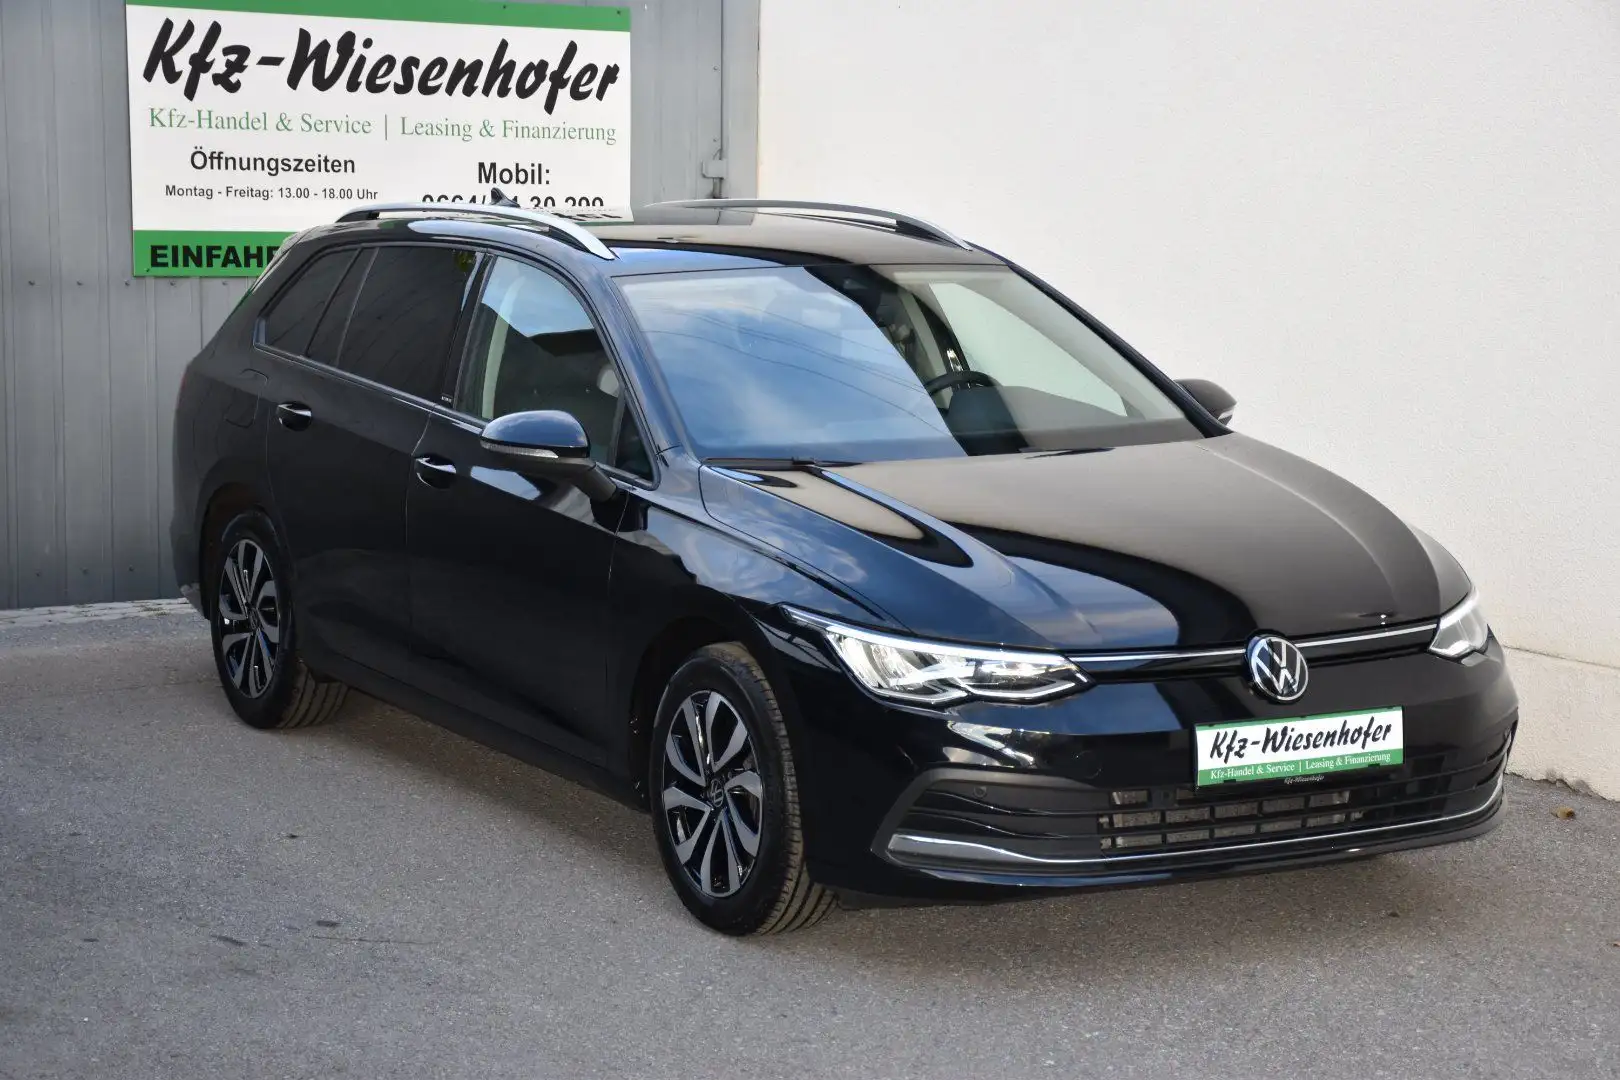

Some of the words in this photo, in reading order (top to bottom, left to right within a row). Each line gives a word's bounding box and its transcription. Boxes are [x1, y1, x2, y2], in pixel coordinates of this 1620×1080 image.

[143, 17, 620, 115] Kfz-Wiesenhofer
[149, 107, 267, 131] Kfz-Handel
[275, 113, 293, 132] &
[301, 113, 372, 133] Service
[400, 116, 472, 141] Leasing
[479, 119, 495, 137] &
[502, 120, 616, 145] Finanzierung
[190, 146, 355, 176] Öffnungszeiten
[478, 162, 550, 184] Mobil:
[165, 185, 214, 199] Montag
[226, 186, 274, 201] Freitag:
[278, 187, 310, 199] 13.00
[322, 188, 353, 200] 18.00
[357, 188, 378, 200] Uhr
[1250, 636, 1308, 700] VW
[1209, 716, 1392, 764] Kfz-Wiesenhofer
[1210, 766, 1254, 780] Kfz-Handel
[1256, 764, 1264, 775] &
[1266, 762, 1295, 774] Service
[1305, 758, 1334, 769] Leasing
[1336, 756, 1343, 765] &
[1344, 753, 1391, 765] Finanzierung
